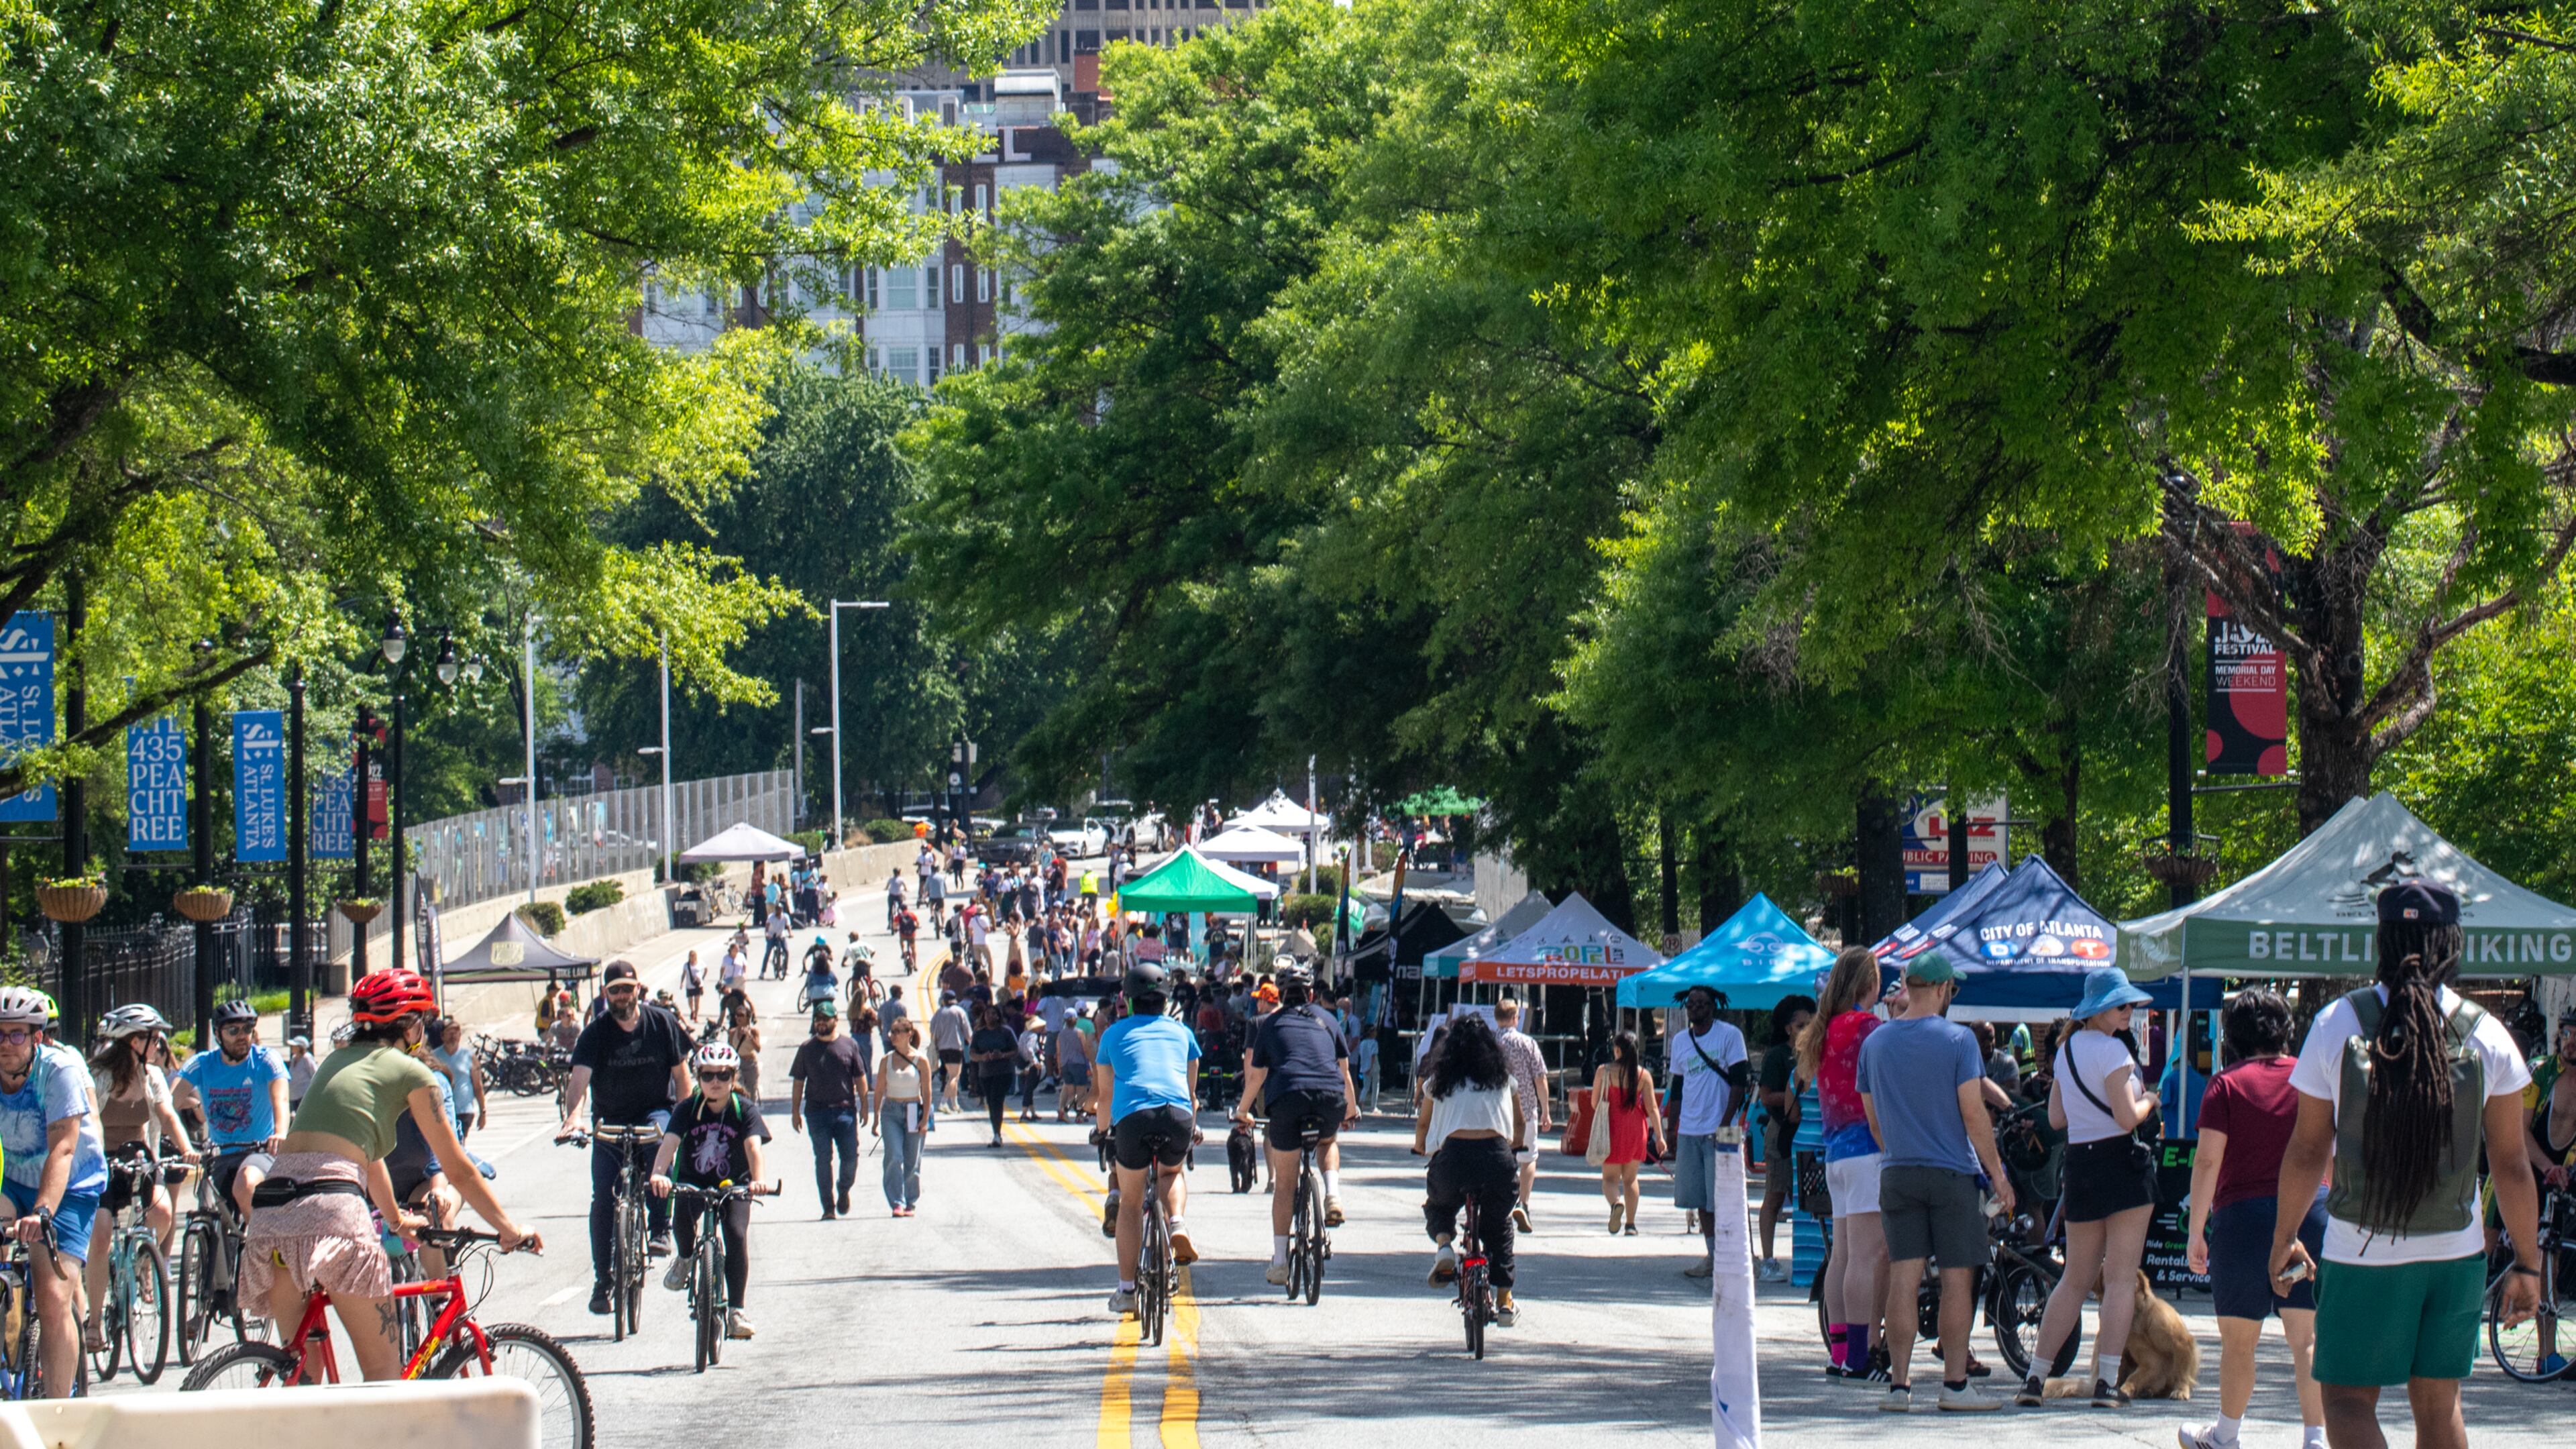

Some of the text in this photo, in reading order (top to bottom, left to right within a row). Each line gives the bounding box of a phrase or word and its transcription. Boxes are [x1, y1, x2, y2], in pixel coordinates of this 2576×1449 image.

[2214, 643, 2276, 655] FESTIVAL
[2215, 665, 2276, 675] MEMORIAL DAY
[2216, 676, 2276, 686] WEEKEND
[21, 685, 41, 714] St.
[130, 735, 182, 762] 435
[132, 763, 184, 788] PEA
[131, 789, 184, 816] CHT
[243, 764, 260, 851] ATLANTA
[260, 763, 276, 849] St. LUKE'S
[312, 793, 351, 812] PEA
[132, 816, 182, 842] REE
[312, 812, 351, 832] CHT
[312, 833, 350, 851] REE
[1980, 920, 2104, 941] CITY OF ATLANTA
[2249, 930, 2572, 963] BELTLI IKING
[1986, 958, 2033, 966] DEPARTMENT
[2047, 958, 2111, 967] TRANSPORTATION
[2157, 1269, 2210, 1283] & Service
